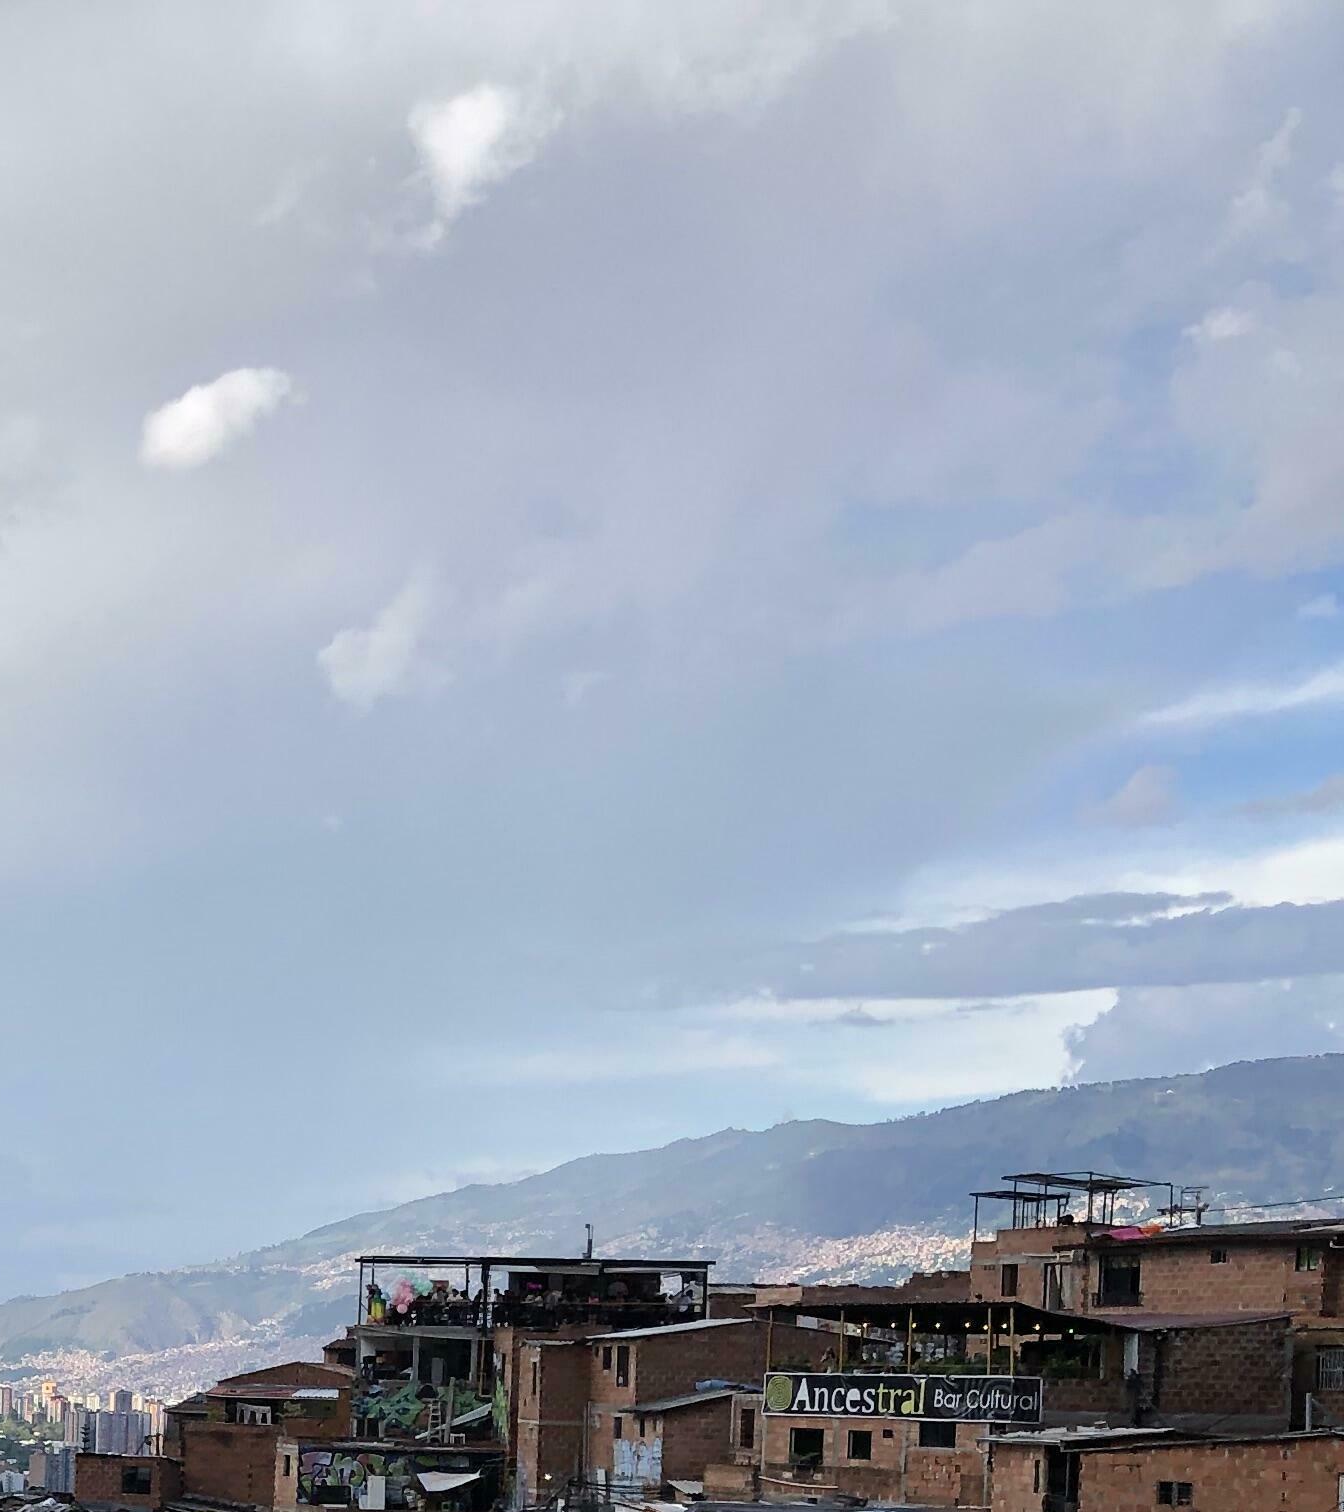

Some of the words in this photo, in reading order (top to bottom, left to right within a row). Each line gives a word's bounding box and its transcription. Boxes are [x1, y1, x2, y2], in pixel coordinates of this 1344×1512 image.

[792, 1377, 926, 1415] Ancestral
[933, 1389, 964, 1409] Bar
[967, 1389, 1038, 1411] Cultural
